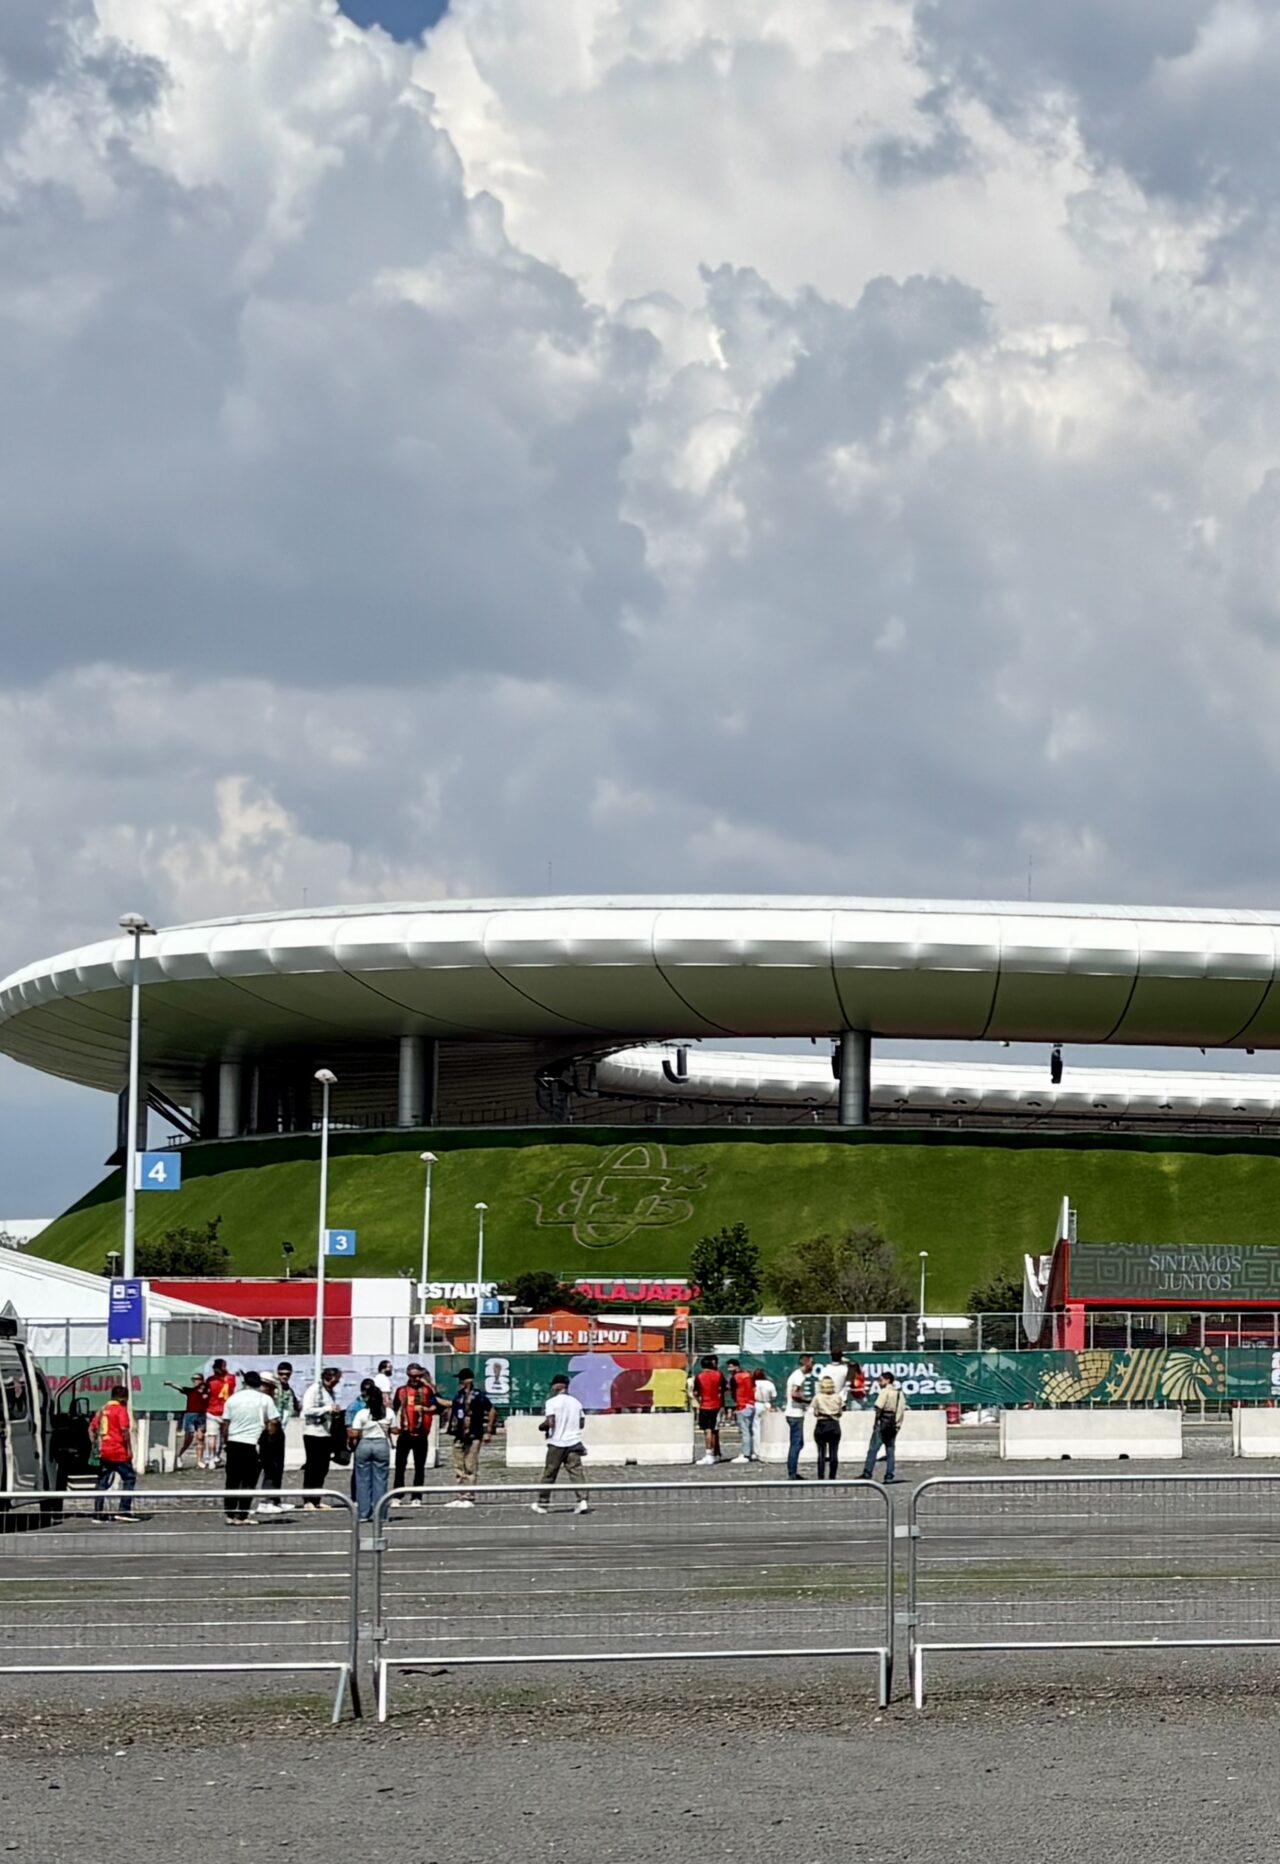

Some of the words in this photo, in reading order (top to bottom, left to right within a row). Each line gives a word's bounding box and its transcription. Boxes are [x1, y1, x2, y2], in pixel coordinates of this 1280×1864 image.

[148, 1161, 167, 1183] 4
[335, 1235, 348, 1250] 3
[1148, 1254, 1241, 1271] SINTAMOS
[1159, 1273, 1232, 1290] JUNTOS
[539, 1330, 573, 1344] OME
[218, 1383, 230, 1400] 4
